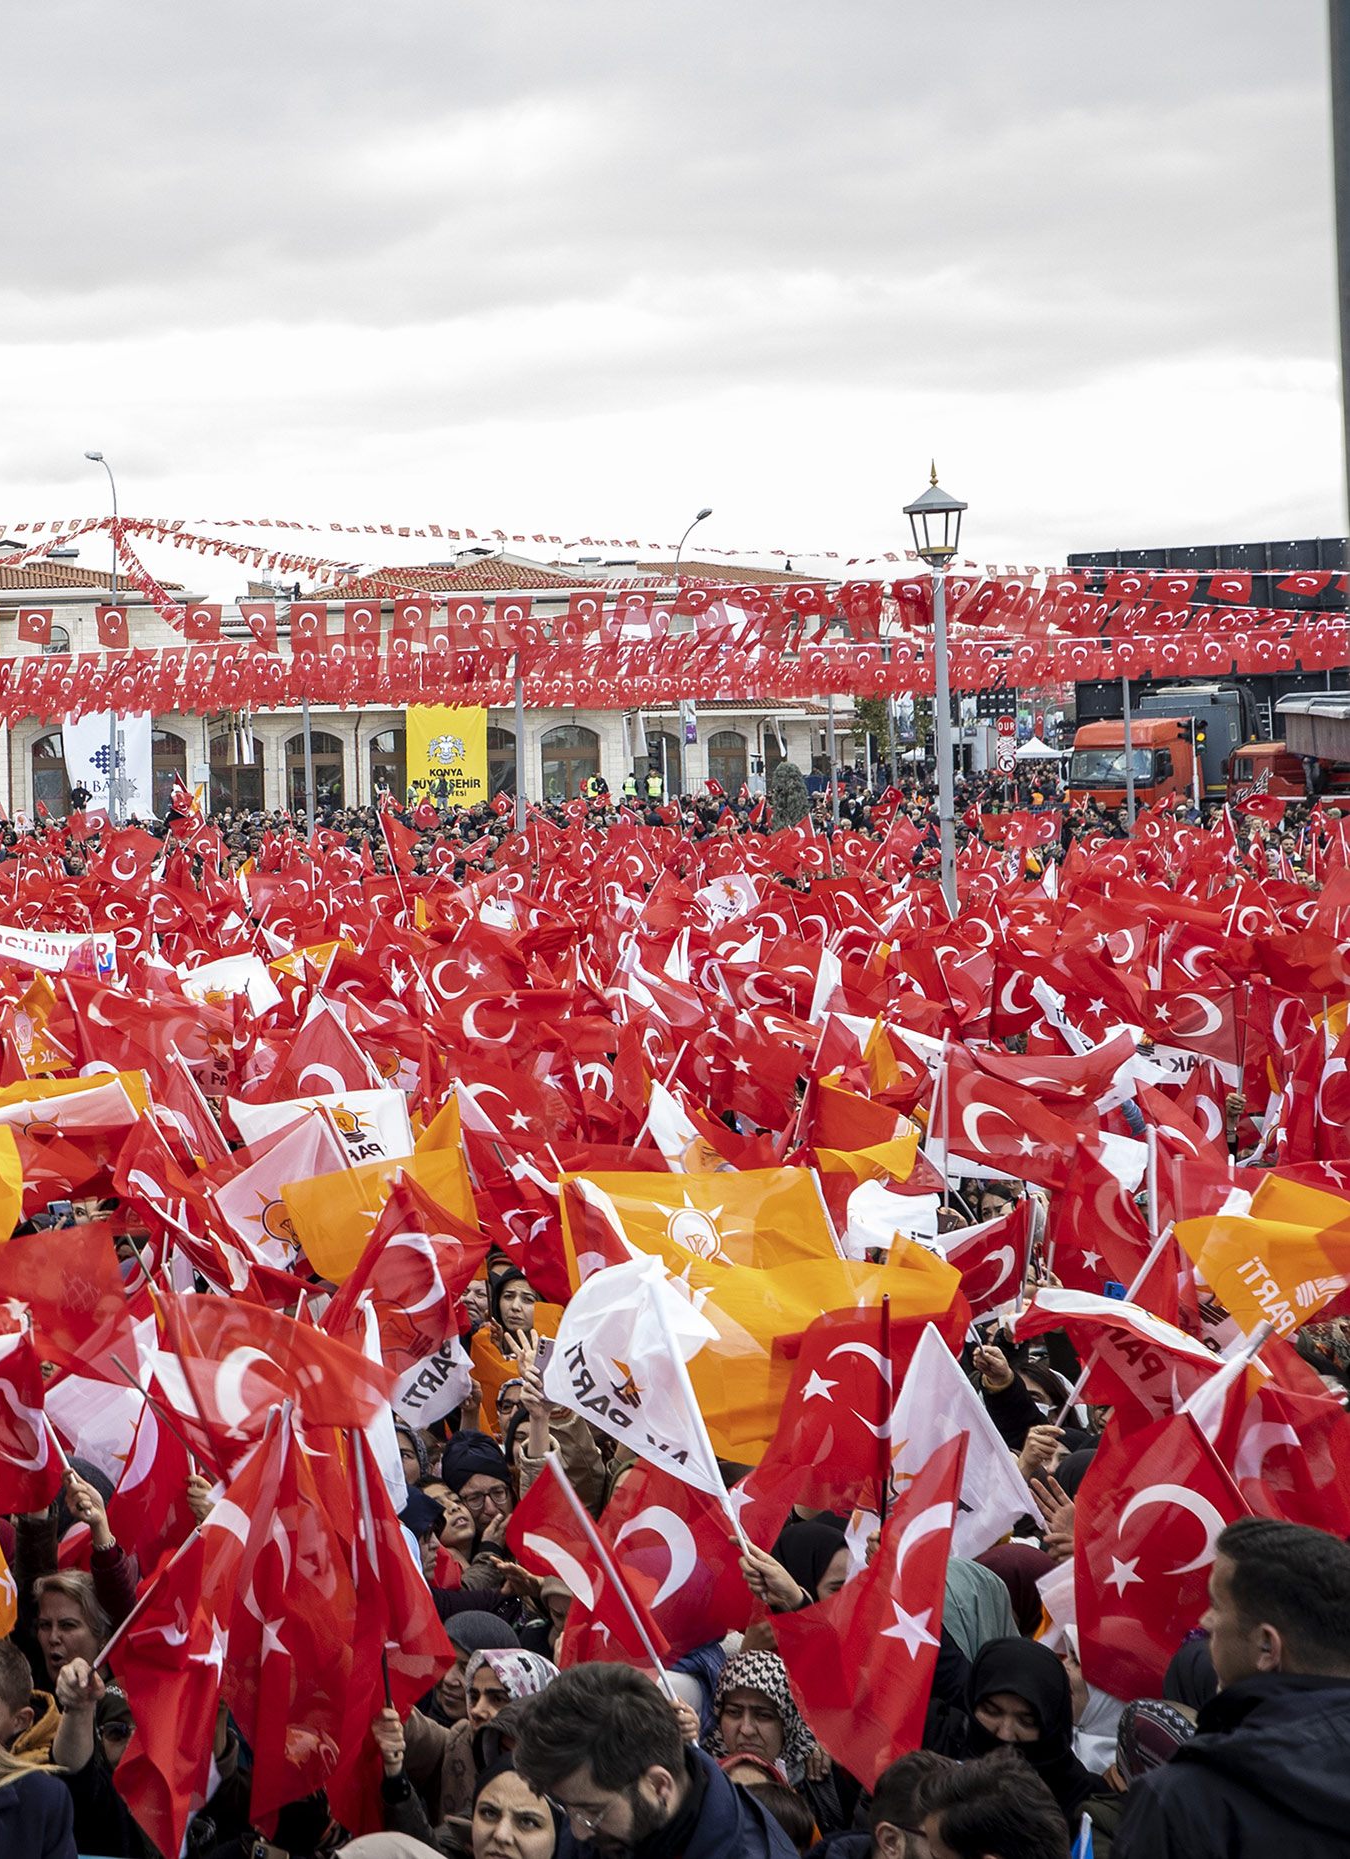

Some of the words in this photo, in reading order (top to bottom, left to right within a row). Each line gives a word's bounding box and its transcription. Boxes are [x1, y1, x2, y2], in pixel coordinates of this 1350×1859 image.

[998, 722, 1015, 731] DUR
[429, 768, 463, 777] KONYA
[418, 776, 481, 790] ÜYŞEHİR
[192, 1070, 205, 1085] K
[211, 1071, 228, 1086] PA
